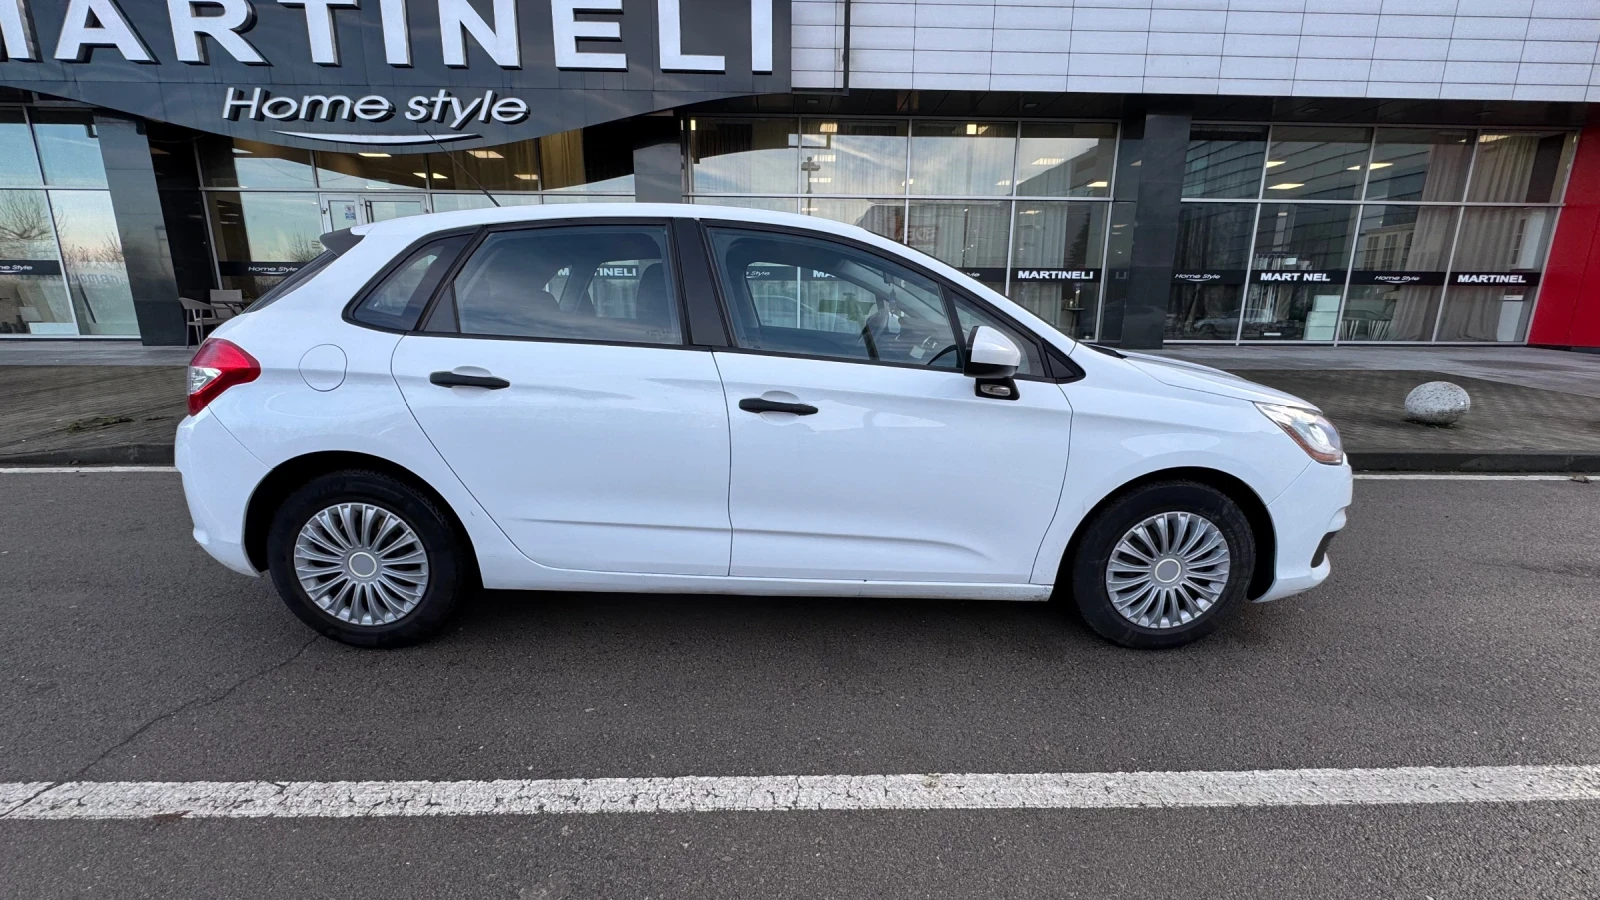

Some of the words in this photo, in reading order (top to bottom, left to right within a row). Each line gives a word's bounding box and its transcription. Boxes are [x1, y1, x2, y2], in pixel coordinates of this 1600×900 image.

[222, 87, 395, 122] Home
[404, 89, 530, 131] style
[12, 264, 33, 272] Style
[278, 266, 298, 274] Style
[1017, 270, 1094, 280] MARTINELI
[1457, 274, 1527, 283] MARTINEL
